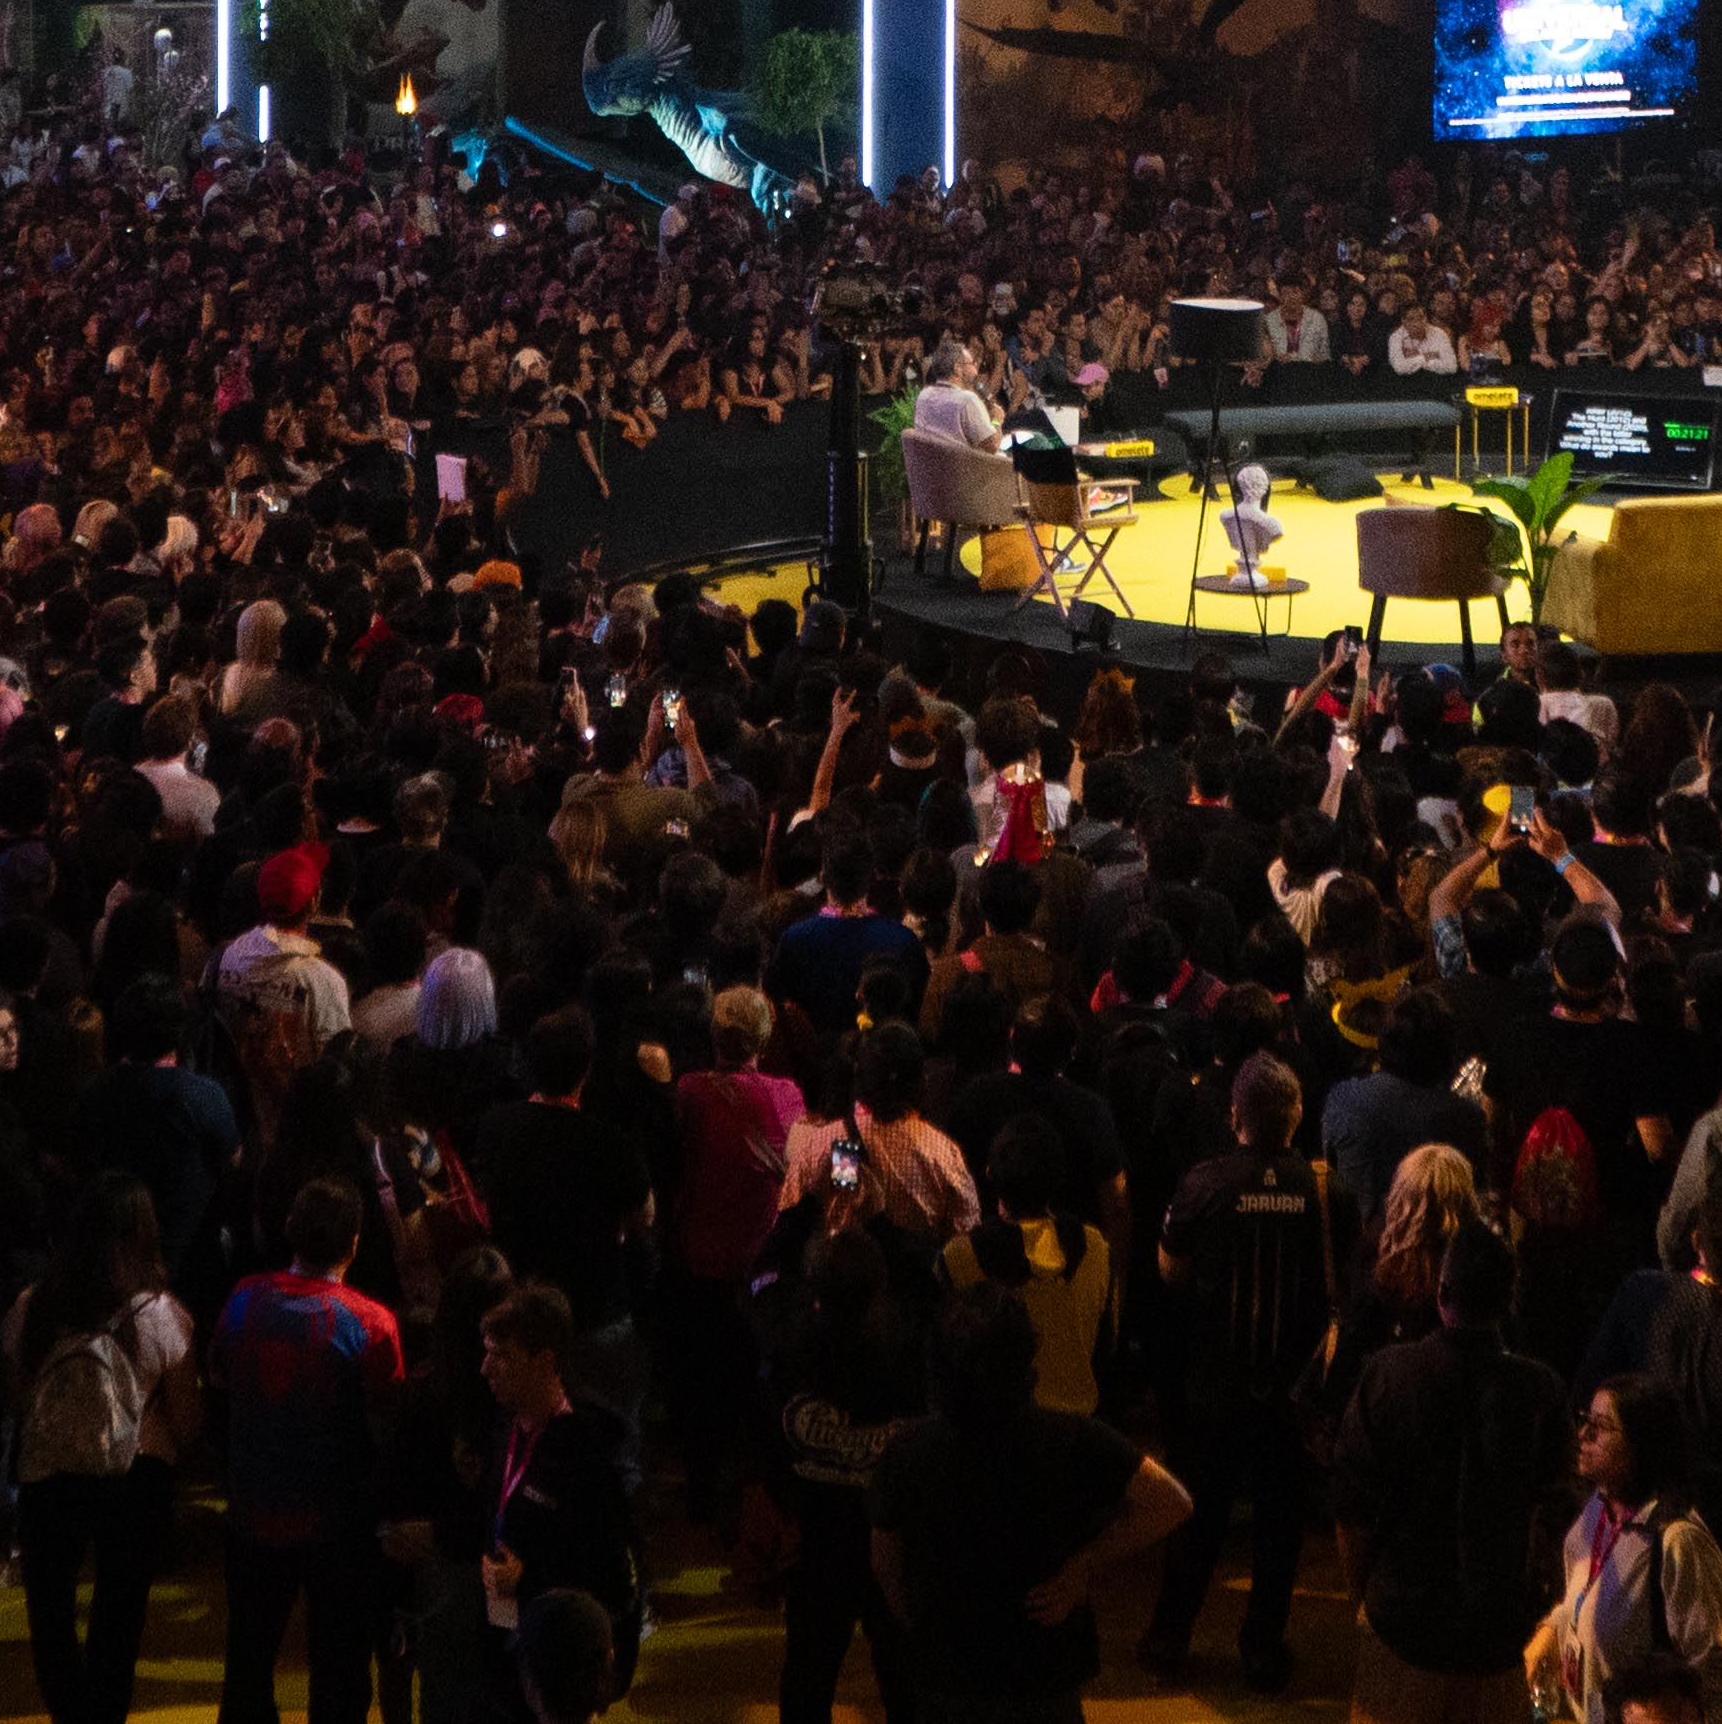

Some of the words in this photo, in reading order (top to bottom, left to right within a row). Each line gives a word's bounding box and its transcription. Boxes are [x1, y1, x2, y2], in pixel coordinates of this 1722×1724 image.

[1554, 74, 1565, 88] A
[1566, 73, 1583, 88] LA
[1666, 428, 1709, 440] 00:21:21
[1235, 1193, 1307, 1214] JARVAN
